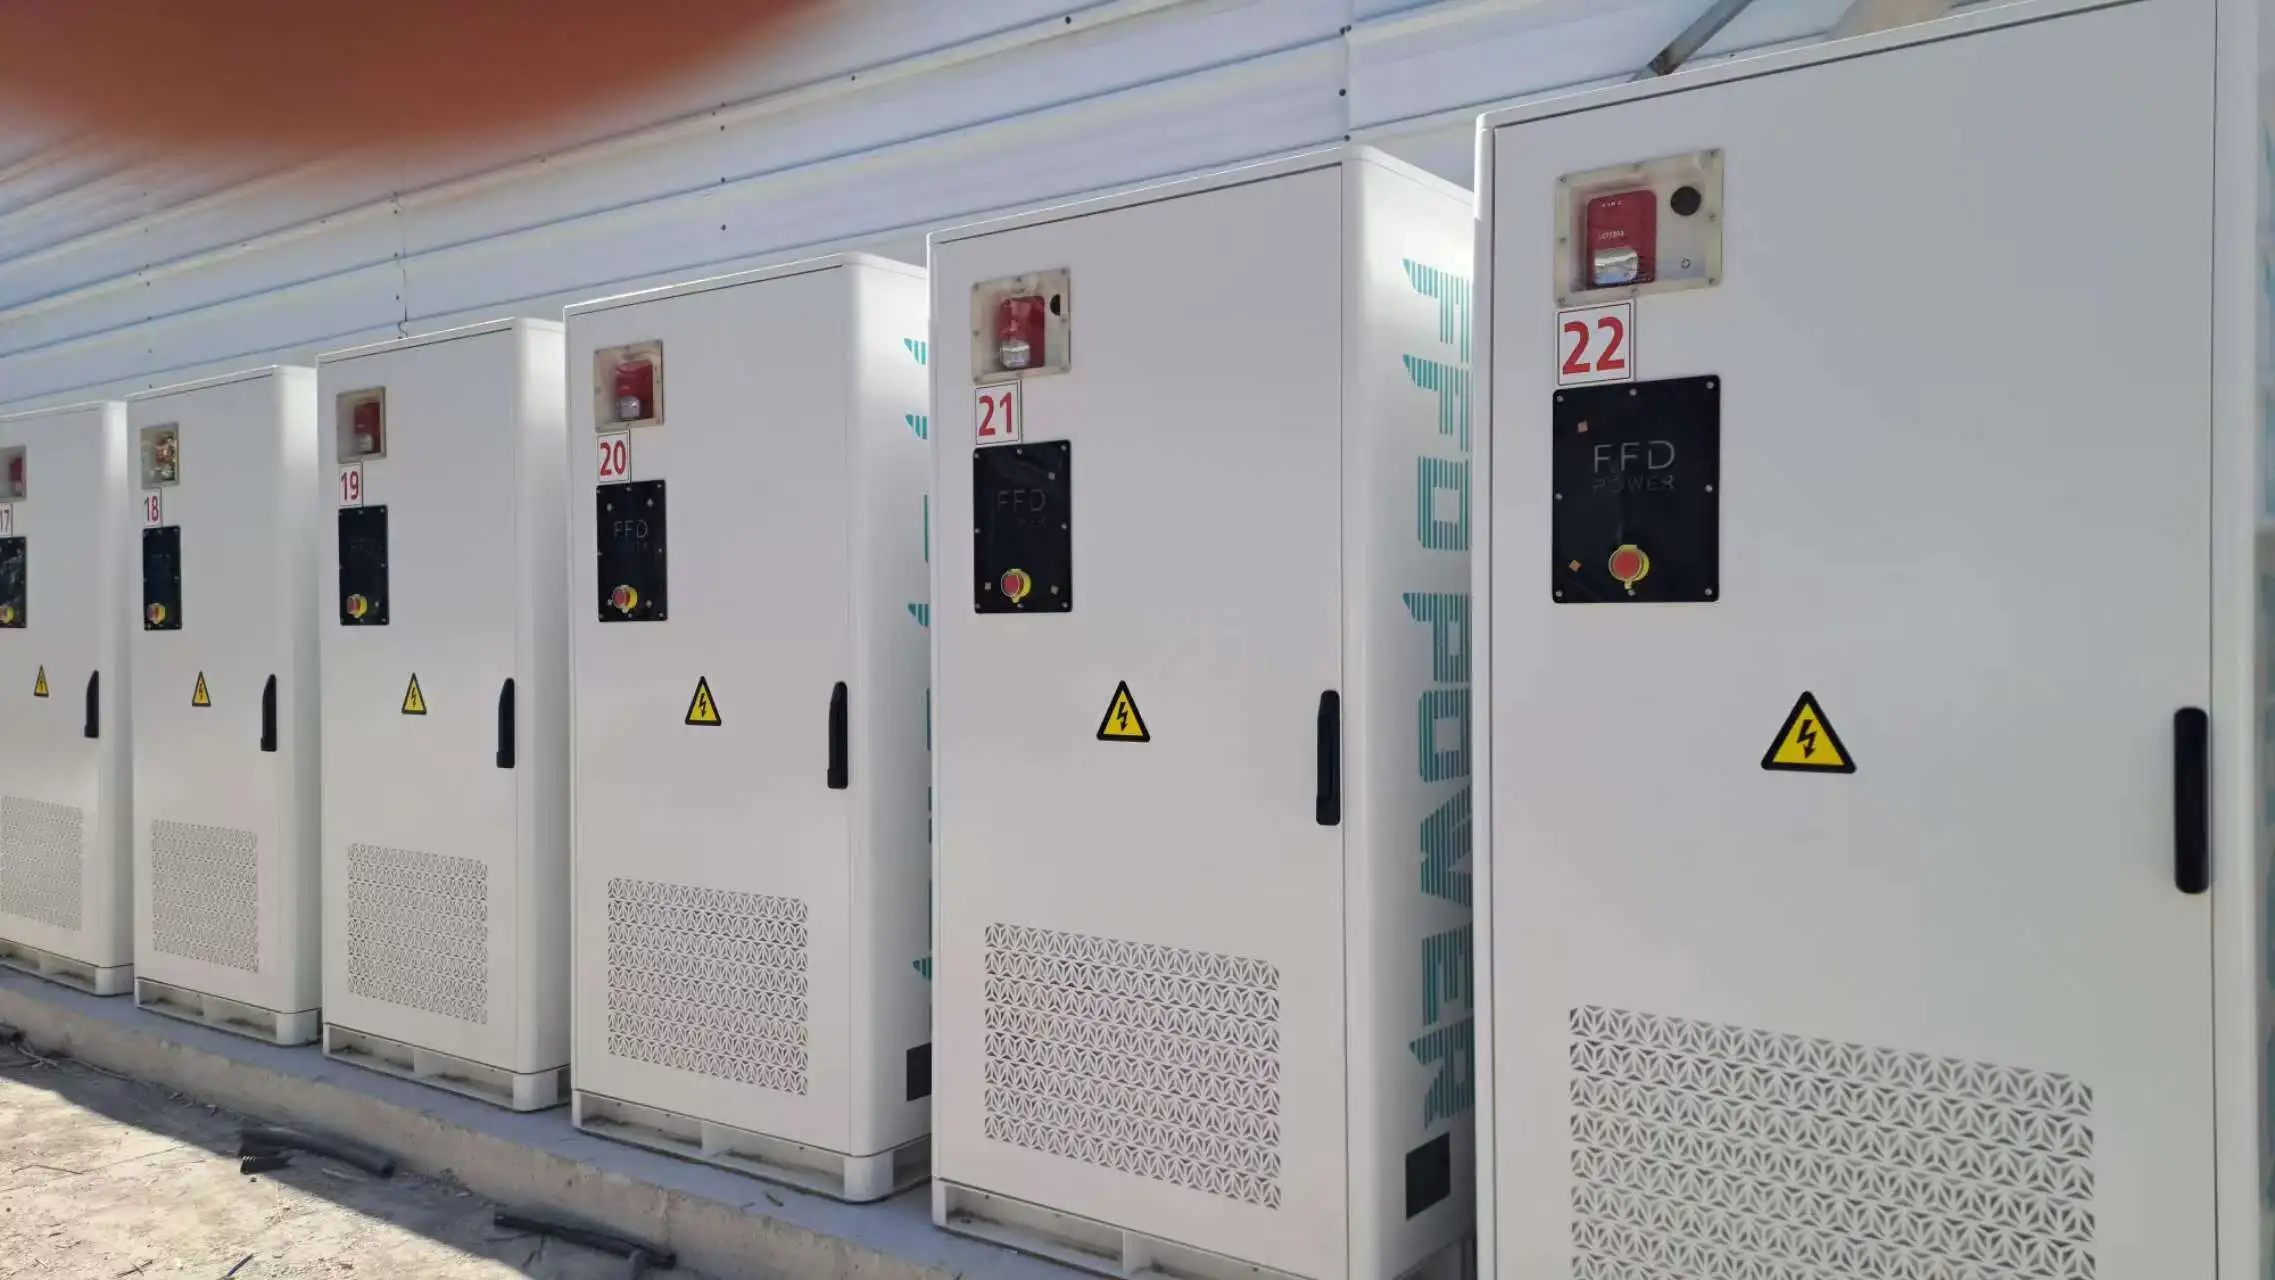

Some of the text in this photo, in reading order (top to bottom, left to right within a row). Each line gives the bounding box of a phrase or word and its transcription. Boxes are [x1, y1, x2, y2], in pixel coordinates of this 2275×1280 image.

[1562, 316, 1625, 375] 22
[978, 391, 1013, 436] 21
[599, 439, 627, 476] 20
[1593, 440, 1675, 473] FFD
[341, 470, 359, 501] 19
[997, 488, 1046, 514] FFD
[143, 495, 159, 521] 18
[613, 518, 649, 540] FFD
[1402, 592, 1474, 1130] POWER
